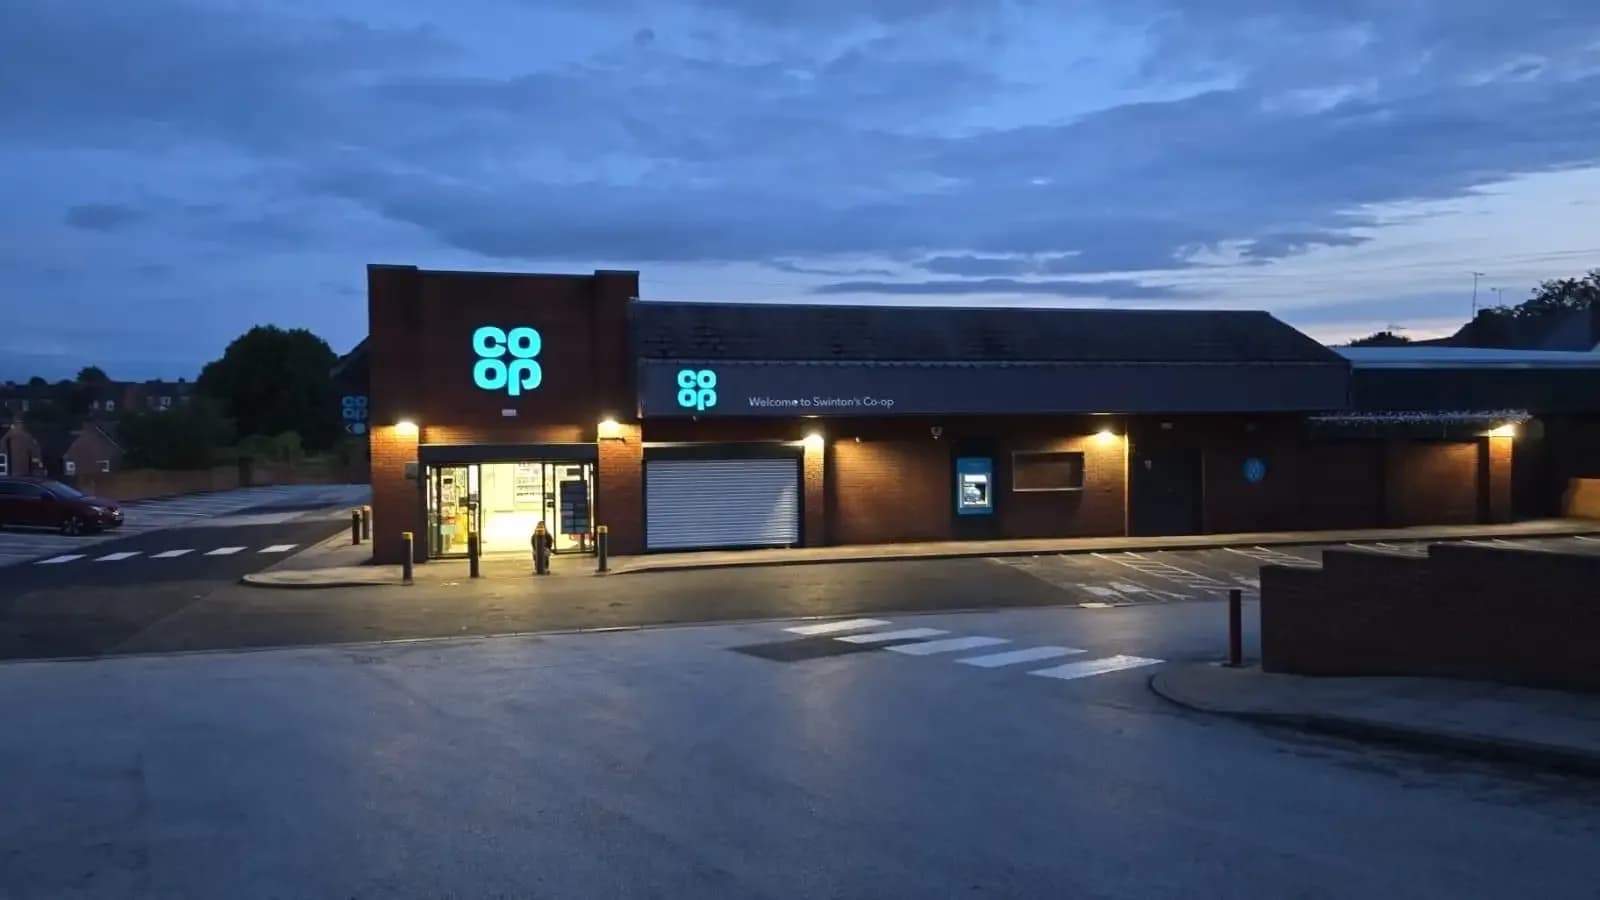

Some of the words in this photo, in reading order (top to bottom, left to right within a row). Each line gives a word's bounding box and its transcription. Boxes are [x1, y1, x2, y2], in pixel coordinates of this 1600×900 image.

[749, 396, 798, 408] Welcome
[800, 397, 811, 408] to
[813, 396, 861, 408] Swinton's
[863, 396, 894, 410] Co-op
